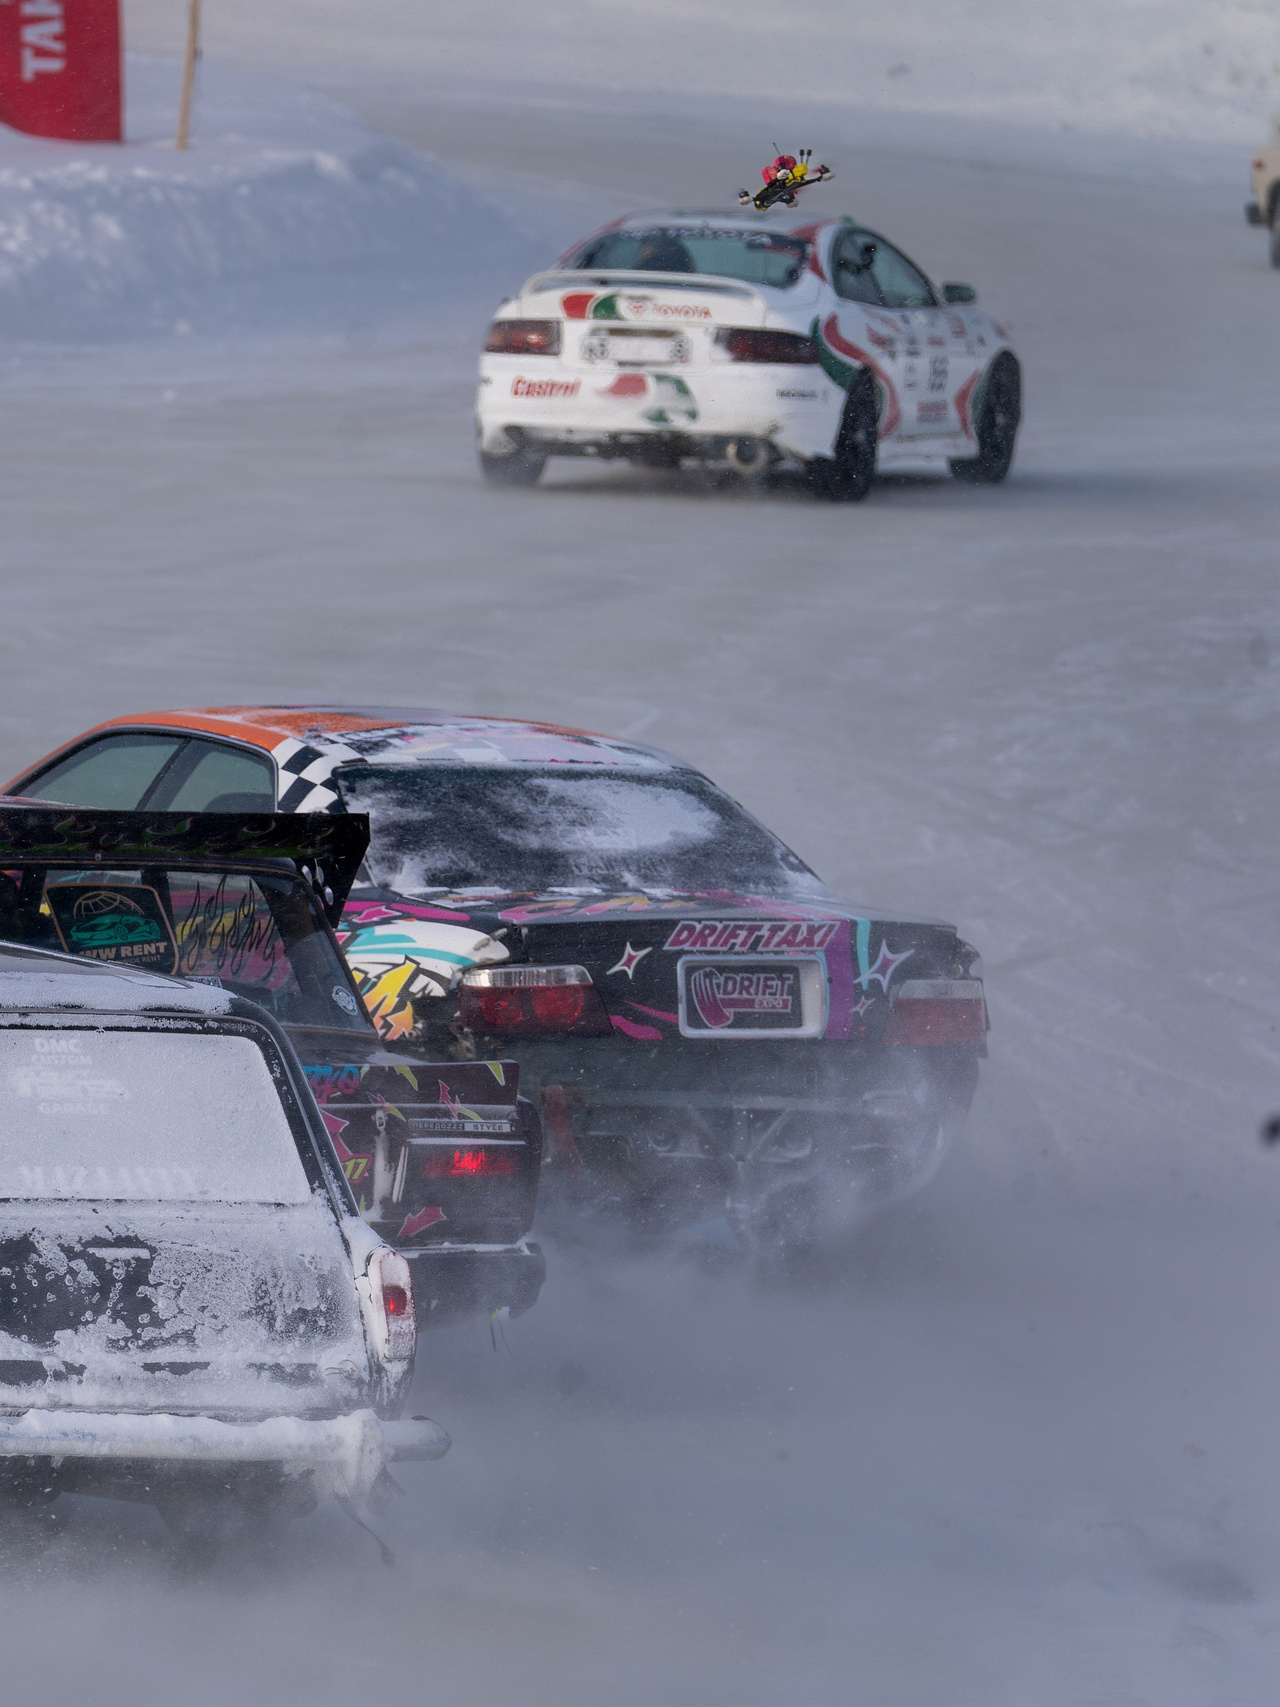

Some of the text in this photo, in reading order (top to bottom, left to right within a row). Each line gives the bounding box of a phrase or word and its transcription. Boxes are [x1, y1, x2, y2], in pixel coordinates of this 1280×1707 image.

[653, 304, 712, 319] TOYOTA
[662, 921, 840, 951] DRIFT TAXI
[120, 941, 167, 957] RENT
[720, 974, 793, 996] DRIFT
[754, 999, 783, 1009] EXPO
[34, 1037, 81, 1053] DMC
[472, 1123, 504, 1131] STYLE
